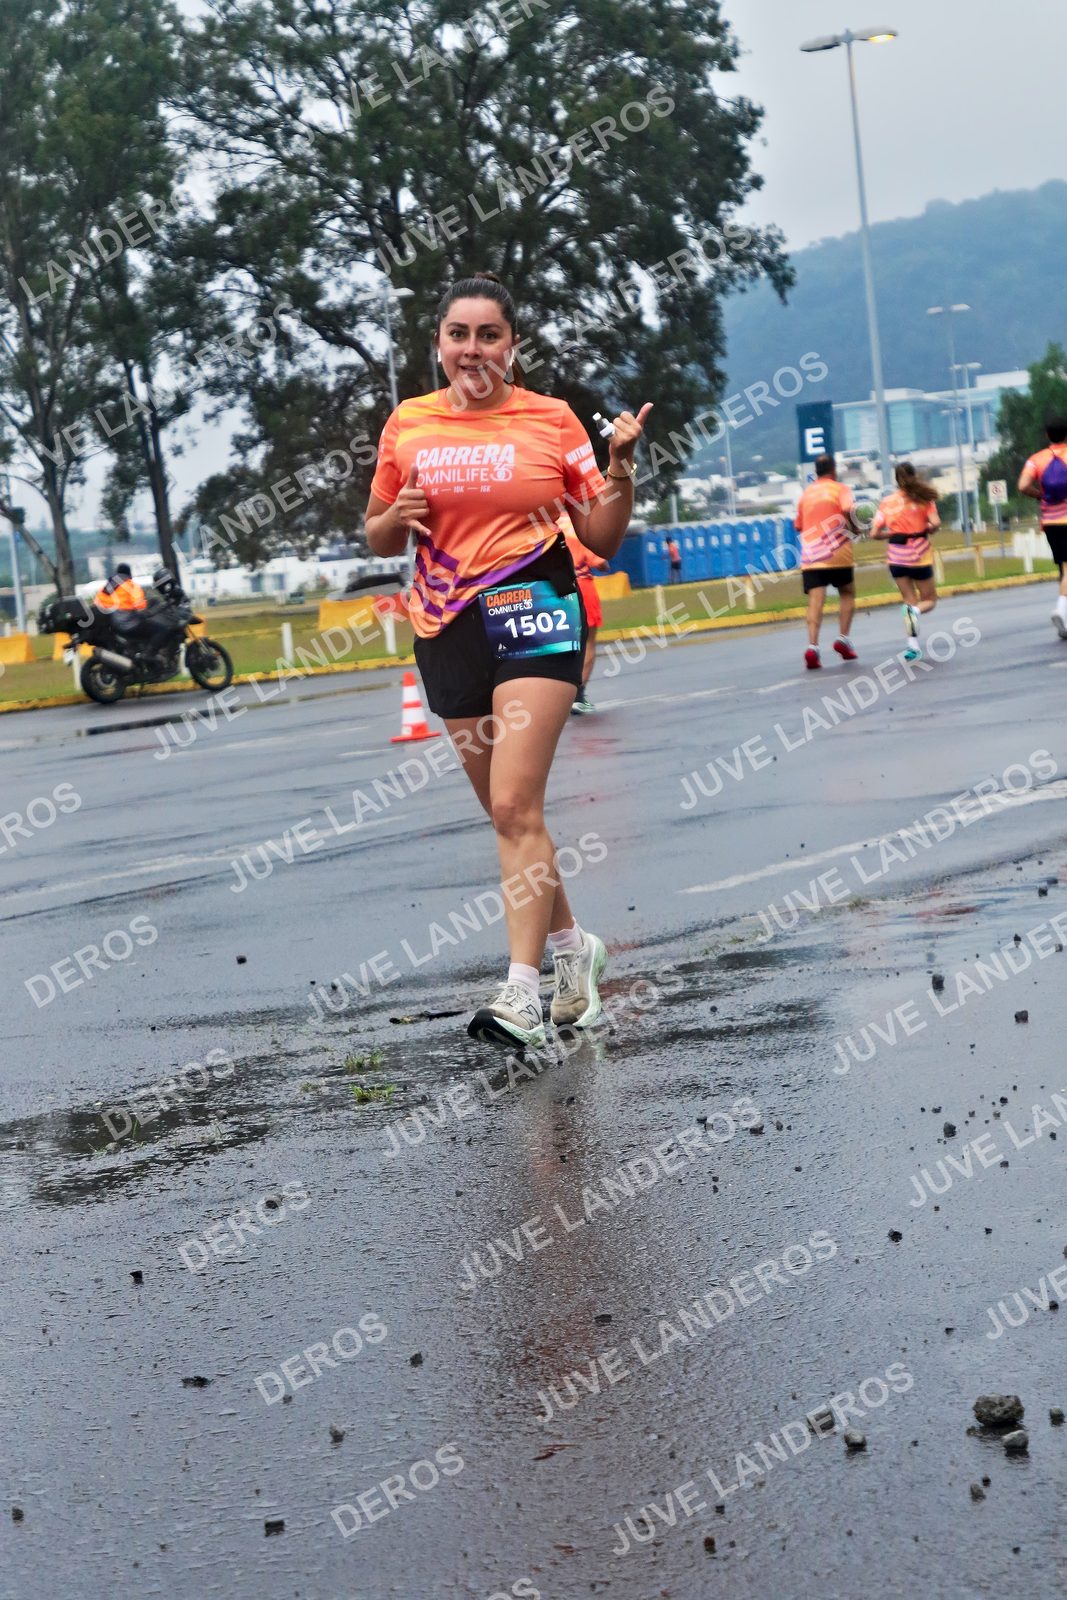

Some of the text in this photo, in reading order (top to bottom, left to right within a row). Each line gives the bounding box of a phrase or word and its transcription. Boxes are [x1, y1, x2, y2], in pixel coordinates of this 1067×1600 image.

[805, 427, 826, 455] E
[416, 444, 516, 470] CARRERA
[416, 467, 489, 487] OMNILIFE
[453, 485, 464, 493] 10K
[487, 589, 532, 607] CARRERA
[488, 603, 524, 616] OMNILIFE
[504, 609, 570, 638] 1502
